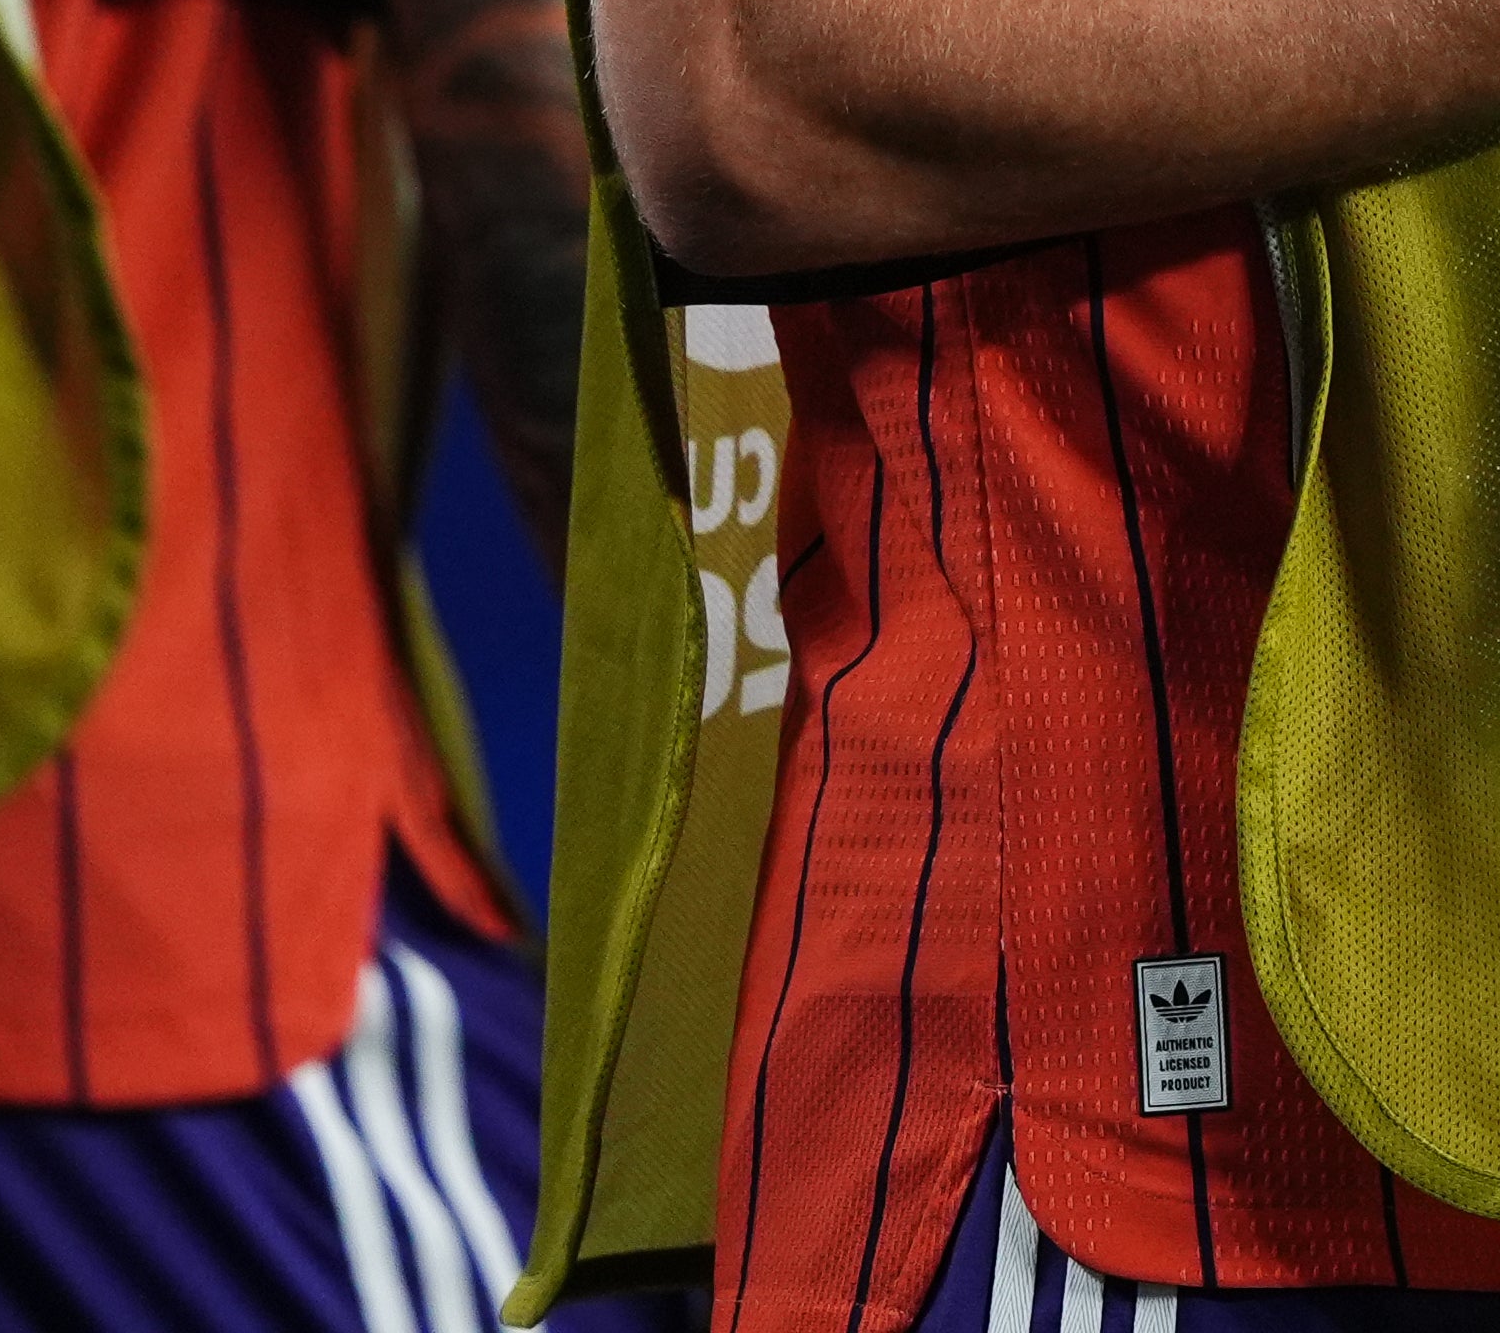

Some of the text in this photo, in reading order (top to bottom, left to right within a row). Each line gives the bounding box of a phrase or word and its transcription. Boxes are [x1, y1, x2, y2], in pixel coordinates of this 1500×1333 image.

[1156, 1036, 1214, 1053] AUTHENTIC
[1160, 1056, 1211, 1072] LICENSED
[1161, 1076, 1211, 1092] PRODUCT
